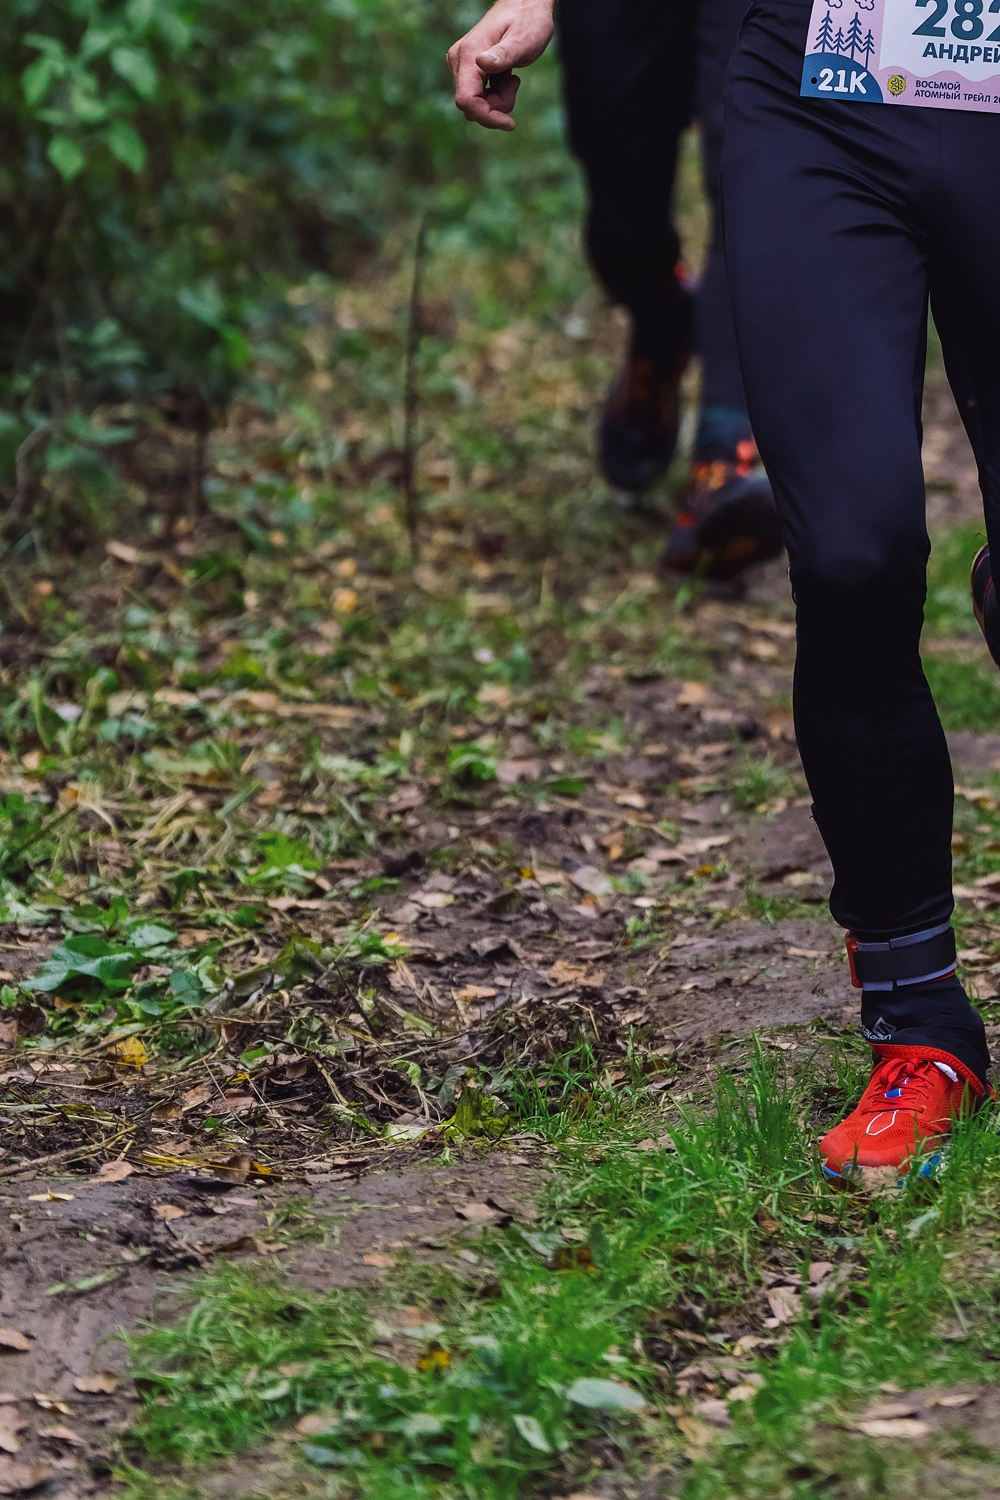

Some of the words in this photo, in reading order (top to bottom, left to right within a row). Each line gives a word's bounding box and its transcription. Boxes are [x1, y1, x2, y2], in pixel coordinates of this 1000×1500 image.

[915, 80, 961, 90] ВОСЬМОЙ
[914, 90, 960, 100] АТОМНЫЙ
[963, 93, 991, 103] ТРЕЙЛ
